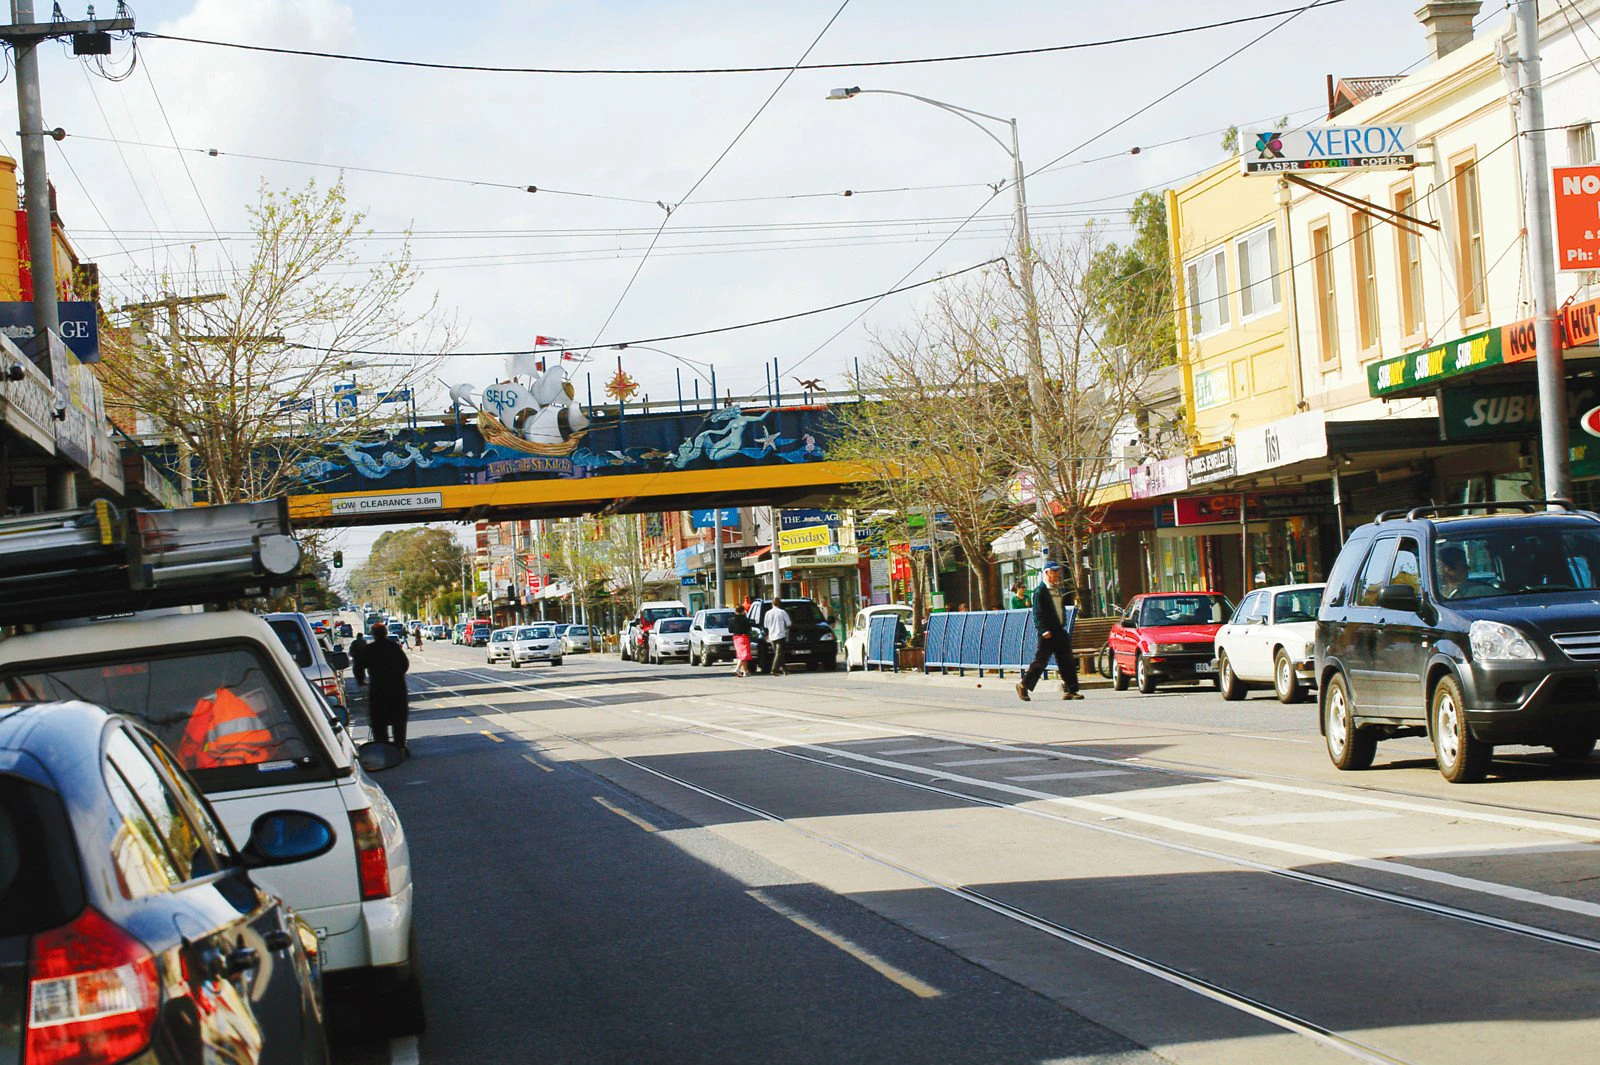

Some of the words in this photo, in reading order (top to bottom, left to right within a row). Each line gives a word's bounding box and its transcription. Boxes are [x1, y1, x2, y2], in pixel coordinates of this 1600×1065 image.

[1306, 126, 1405, 157] XEROX
[1256, 161, 1299, 172] LASER
[1304, 159, 1355, 169] COLOUR
[1360, 156, 1407, 166] COPIES
[1562, 174, 1600, 196] NO
[1567, 248, 1593, 262] Ph:
[58, 320, 90, 339] GE
[1571, 304, 1596, 340] HUT
[1455, 333, 1490, 371] SUBWAY
[1415, 347, 1446, 381] SUBWAY
[1376, 359, 1406, 391] SUBWAY
[336, 501, 356, 510] LOW
[360, 498, 412, 509] CLEARANCE
[416, 497, 437, 505] 3.8m
[783, 515, 801, 524] THE
[781, 531, 827, 548] Sunday
